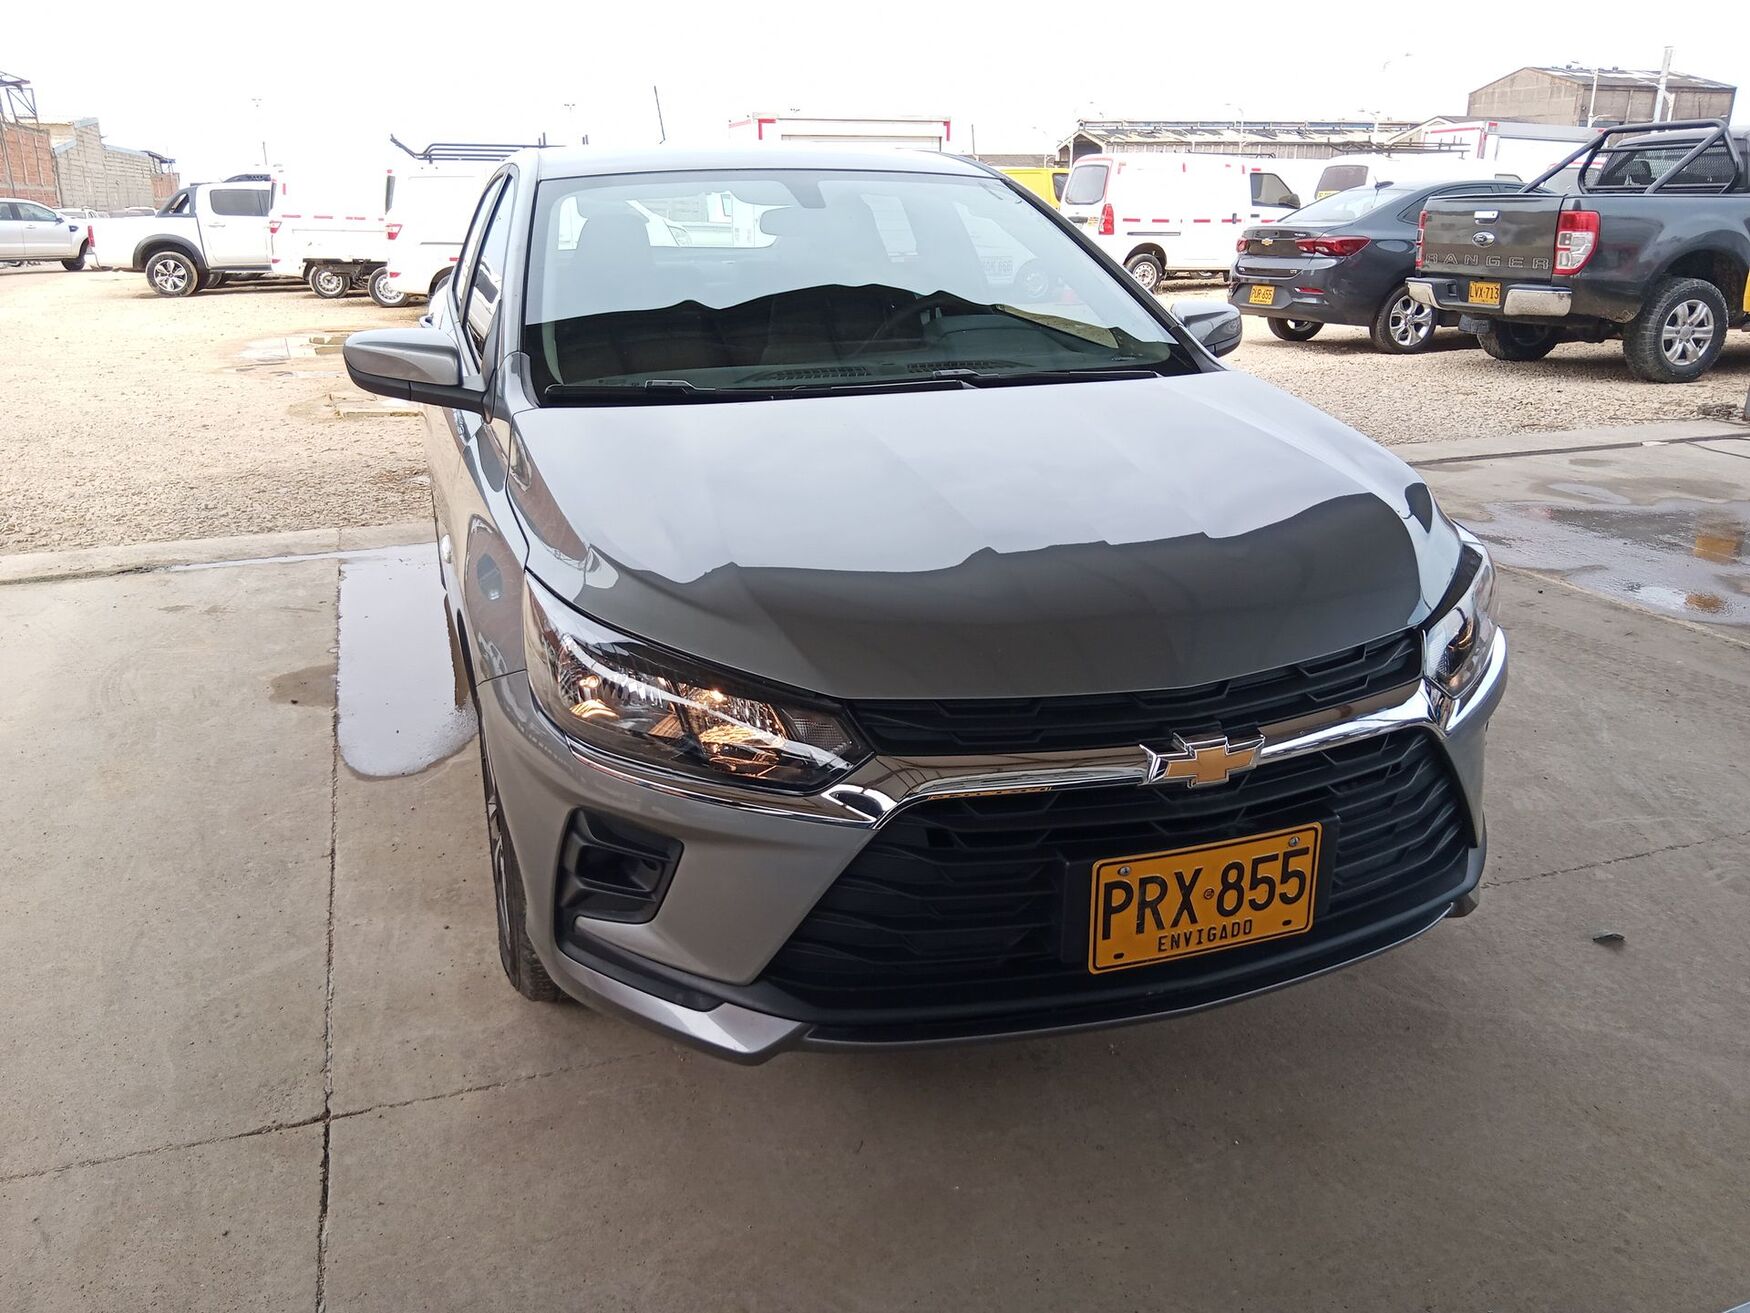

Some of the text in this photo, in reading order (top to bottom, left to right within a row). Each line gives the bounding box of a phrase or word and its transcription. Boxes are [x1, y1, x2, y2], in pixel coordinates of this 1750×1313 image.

[1425, 253, 1549, 270] RANGER
[1485, 286, 1499, 300] 713
[1101, 846, 1310, 940] PRX 855
[1157, 919, 1253, 953] ENVIGADO
